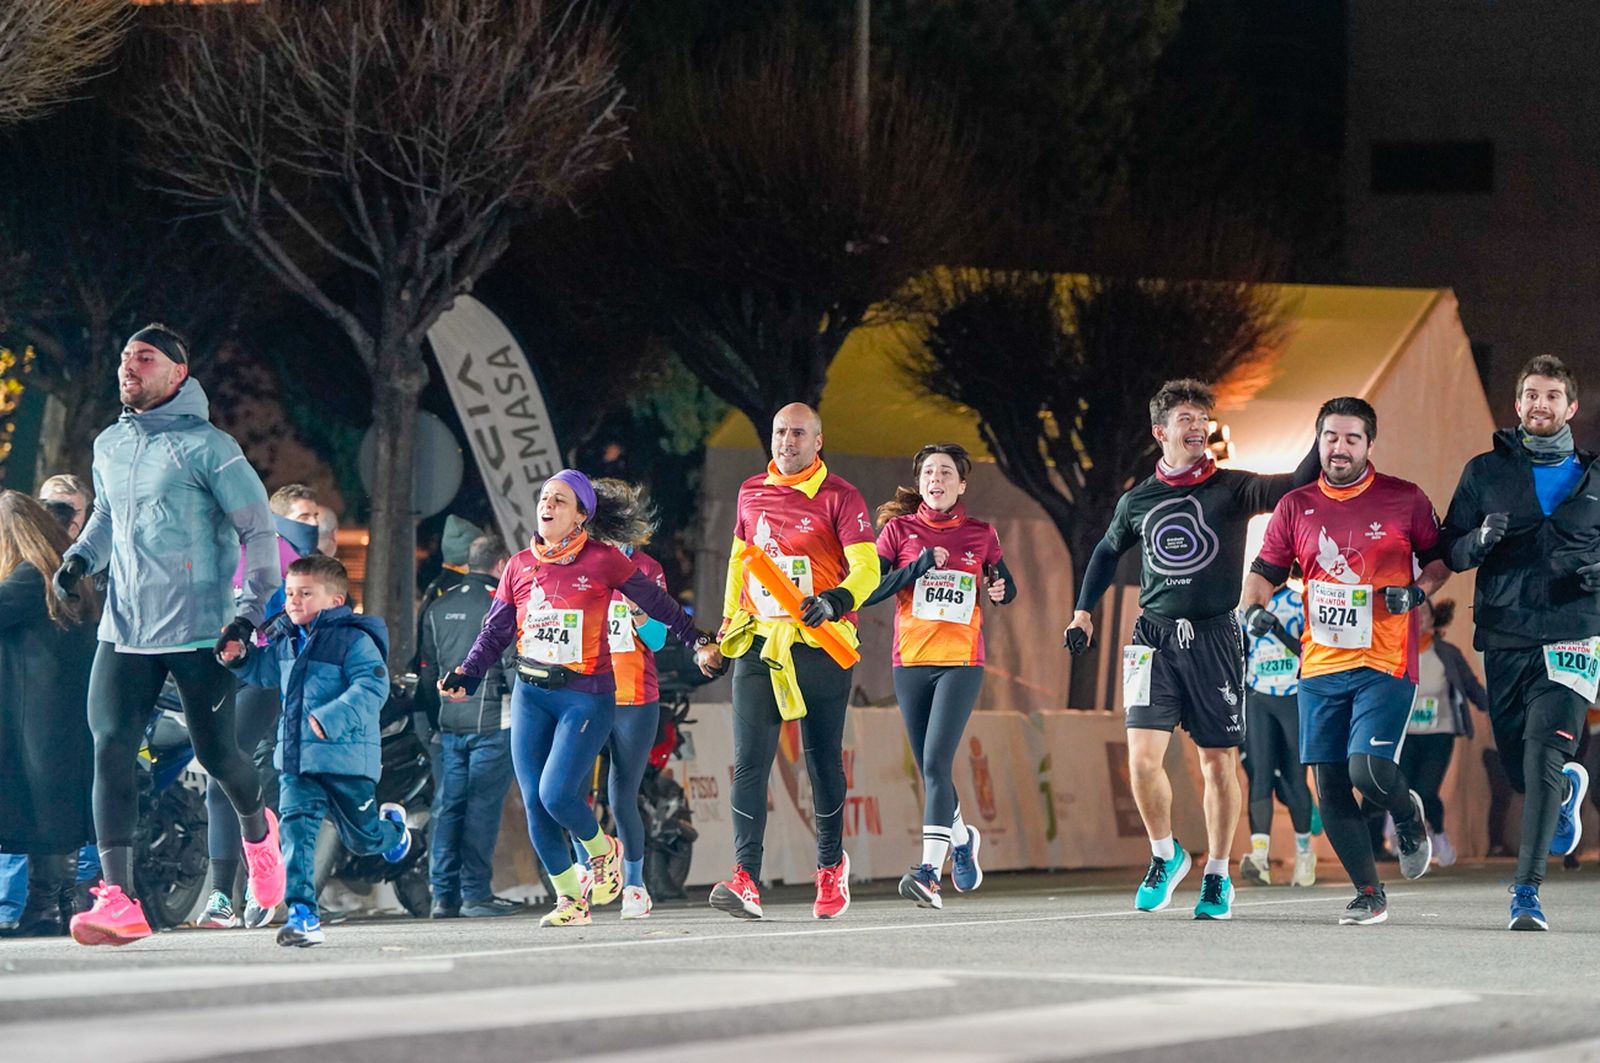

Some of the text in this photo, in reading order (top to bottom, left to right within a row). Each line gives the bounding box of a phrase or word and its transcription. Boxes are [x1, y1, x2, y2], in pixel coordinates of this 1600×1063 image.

[488, 345, 553, 503] EMASA
[925, 588, 965, 605] 6443
[1318, 605, 1358, 627] 5274
[1260, 658, 1294, 673] 12376
